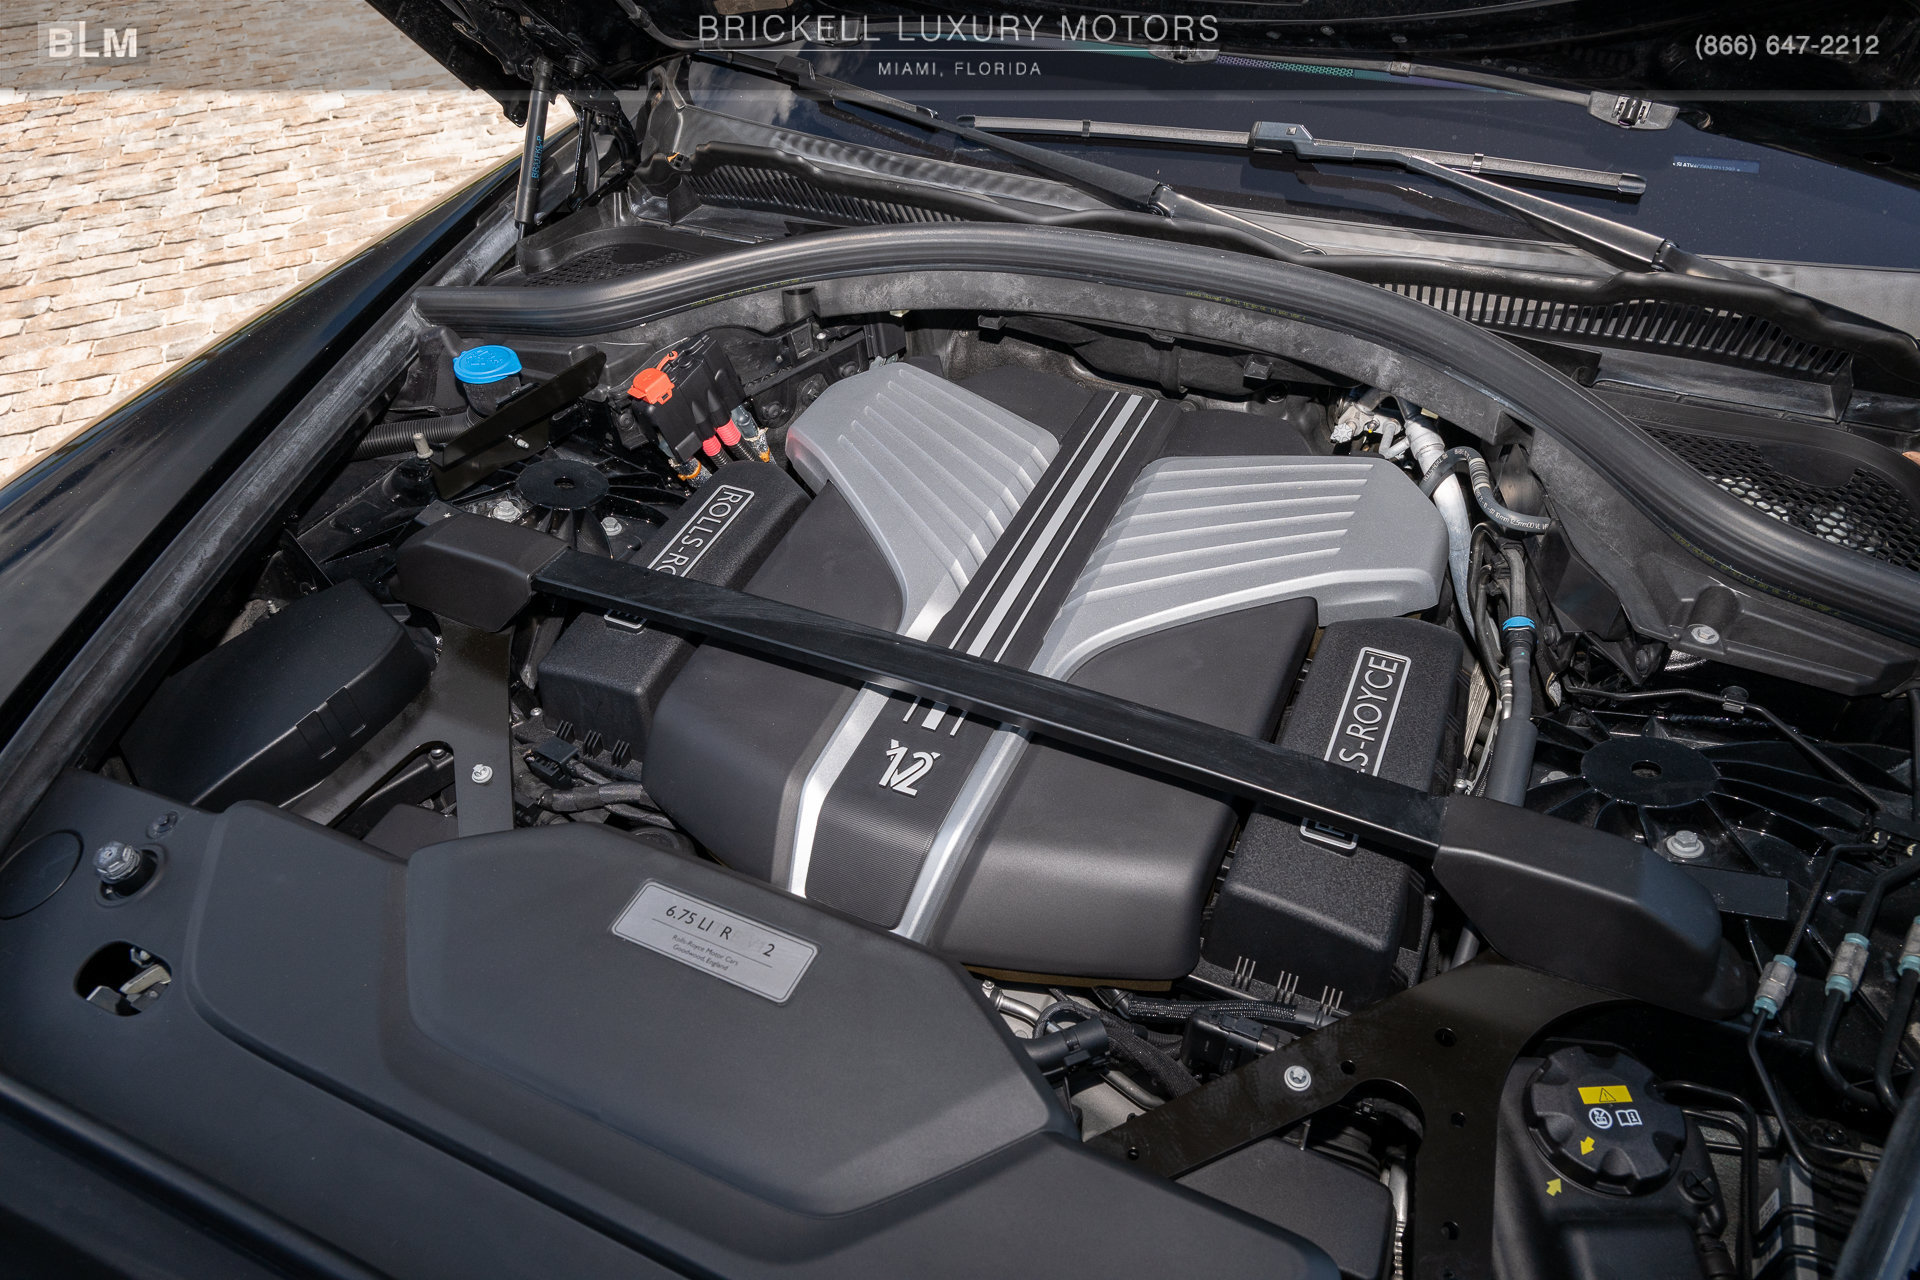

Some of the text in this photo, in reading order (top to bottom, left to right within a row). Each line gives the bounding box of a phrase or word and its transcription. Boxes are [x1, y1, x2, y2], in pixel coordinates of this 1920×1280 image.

[1338, 656, 1399, 774] S-ROYCE
[665, 905, 698, 925] 6.75
[705, 947, 725, 959] Motor
[724, 956, 739, 966] Cars
[705, 958, 730, 972] England
